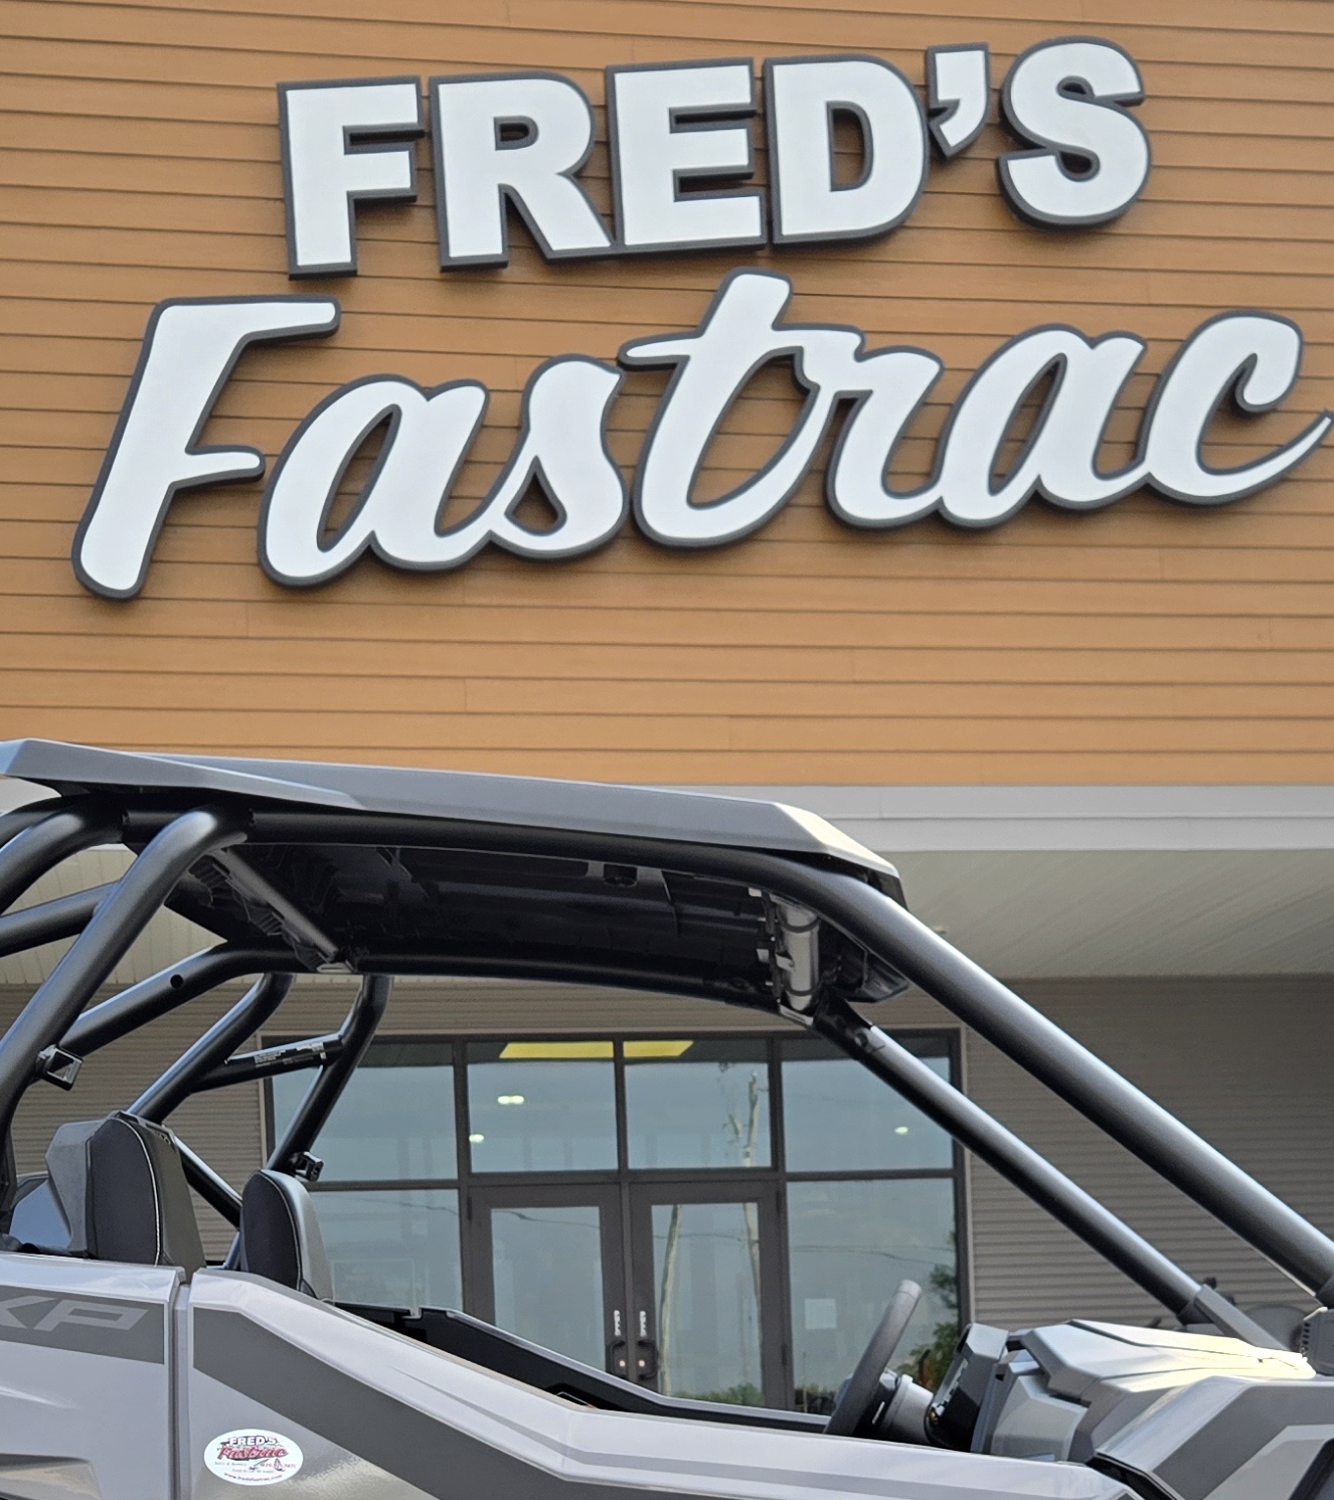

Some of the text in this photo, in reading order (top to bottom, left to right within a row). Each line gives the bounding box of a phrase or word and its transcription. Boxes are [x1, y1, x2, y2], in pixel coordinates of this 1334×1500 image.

[279, 36, 1151, 276] FRED'S
[73, 267, 1334, 597] Fastrac
[229, 1435, 277, 1446] FRED'S
